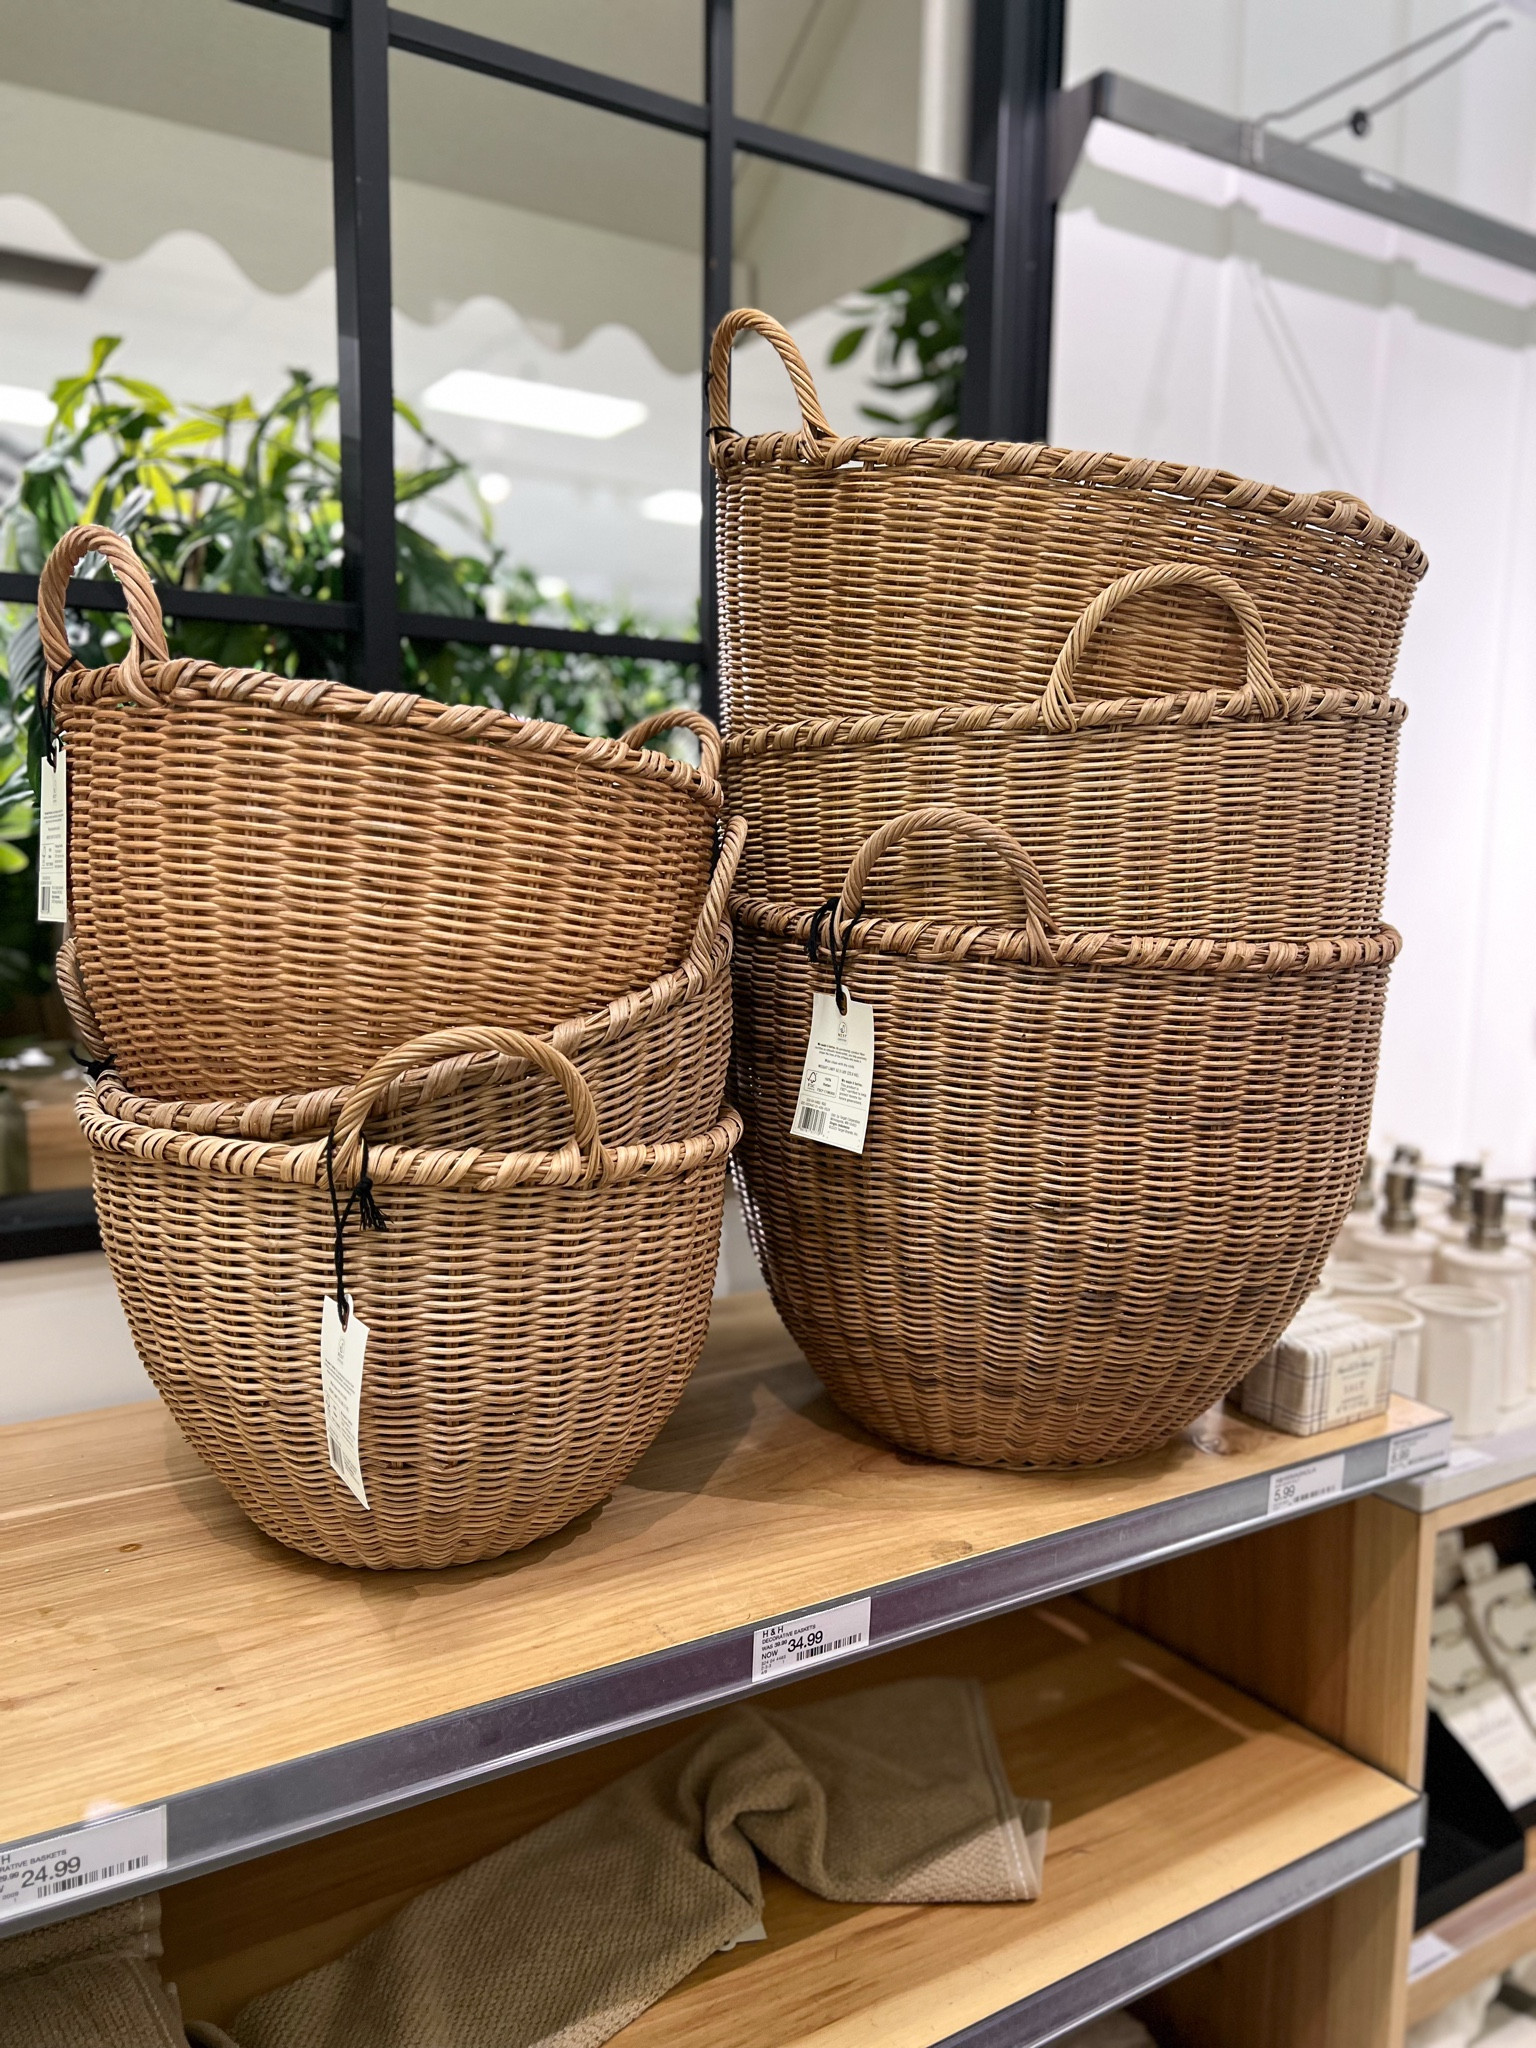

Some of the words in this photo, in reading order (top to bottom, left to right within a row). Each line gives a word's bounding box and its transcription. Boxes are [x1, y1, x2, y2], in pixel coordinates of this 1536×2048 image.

[1274, 1484, 1295, 1502] 5.99
[762, 1628, 769, 1638] H
[770, 1627, 776, 1637] &
[777, 1626, 784, 1635] H
[762, 1631, 793, 1645] DECORATIVE
[794, 1624, 816, 1637] BASKETS
[761, 1649, 779, 1660] NOW
[787, 1630, 823, 1653] 34.99
[762, 1644, 774, 1652] WAS
[1, 1854, 11, 1864] H
[30, 1849, 67, 1865] BASKETS
[21, 1856, 81, 1889] 24.99
